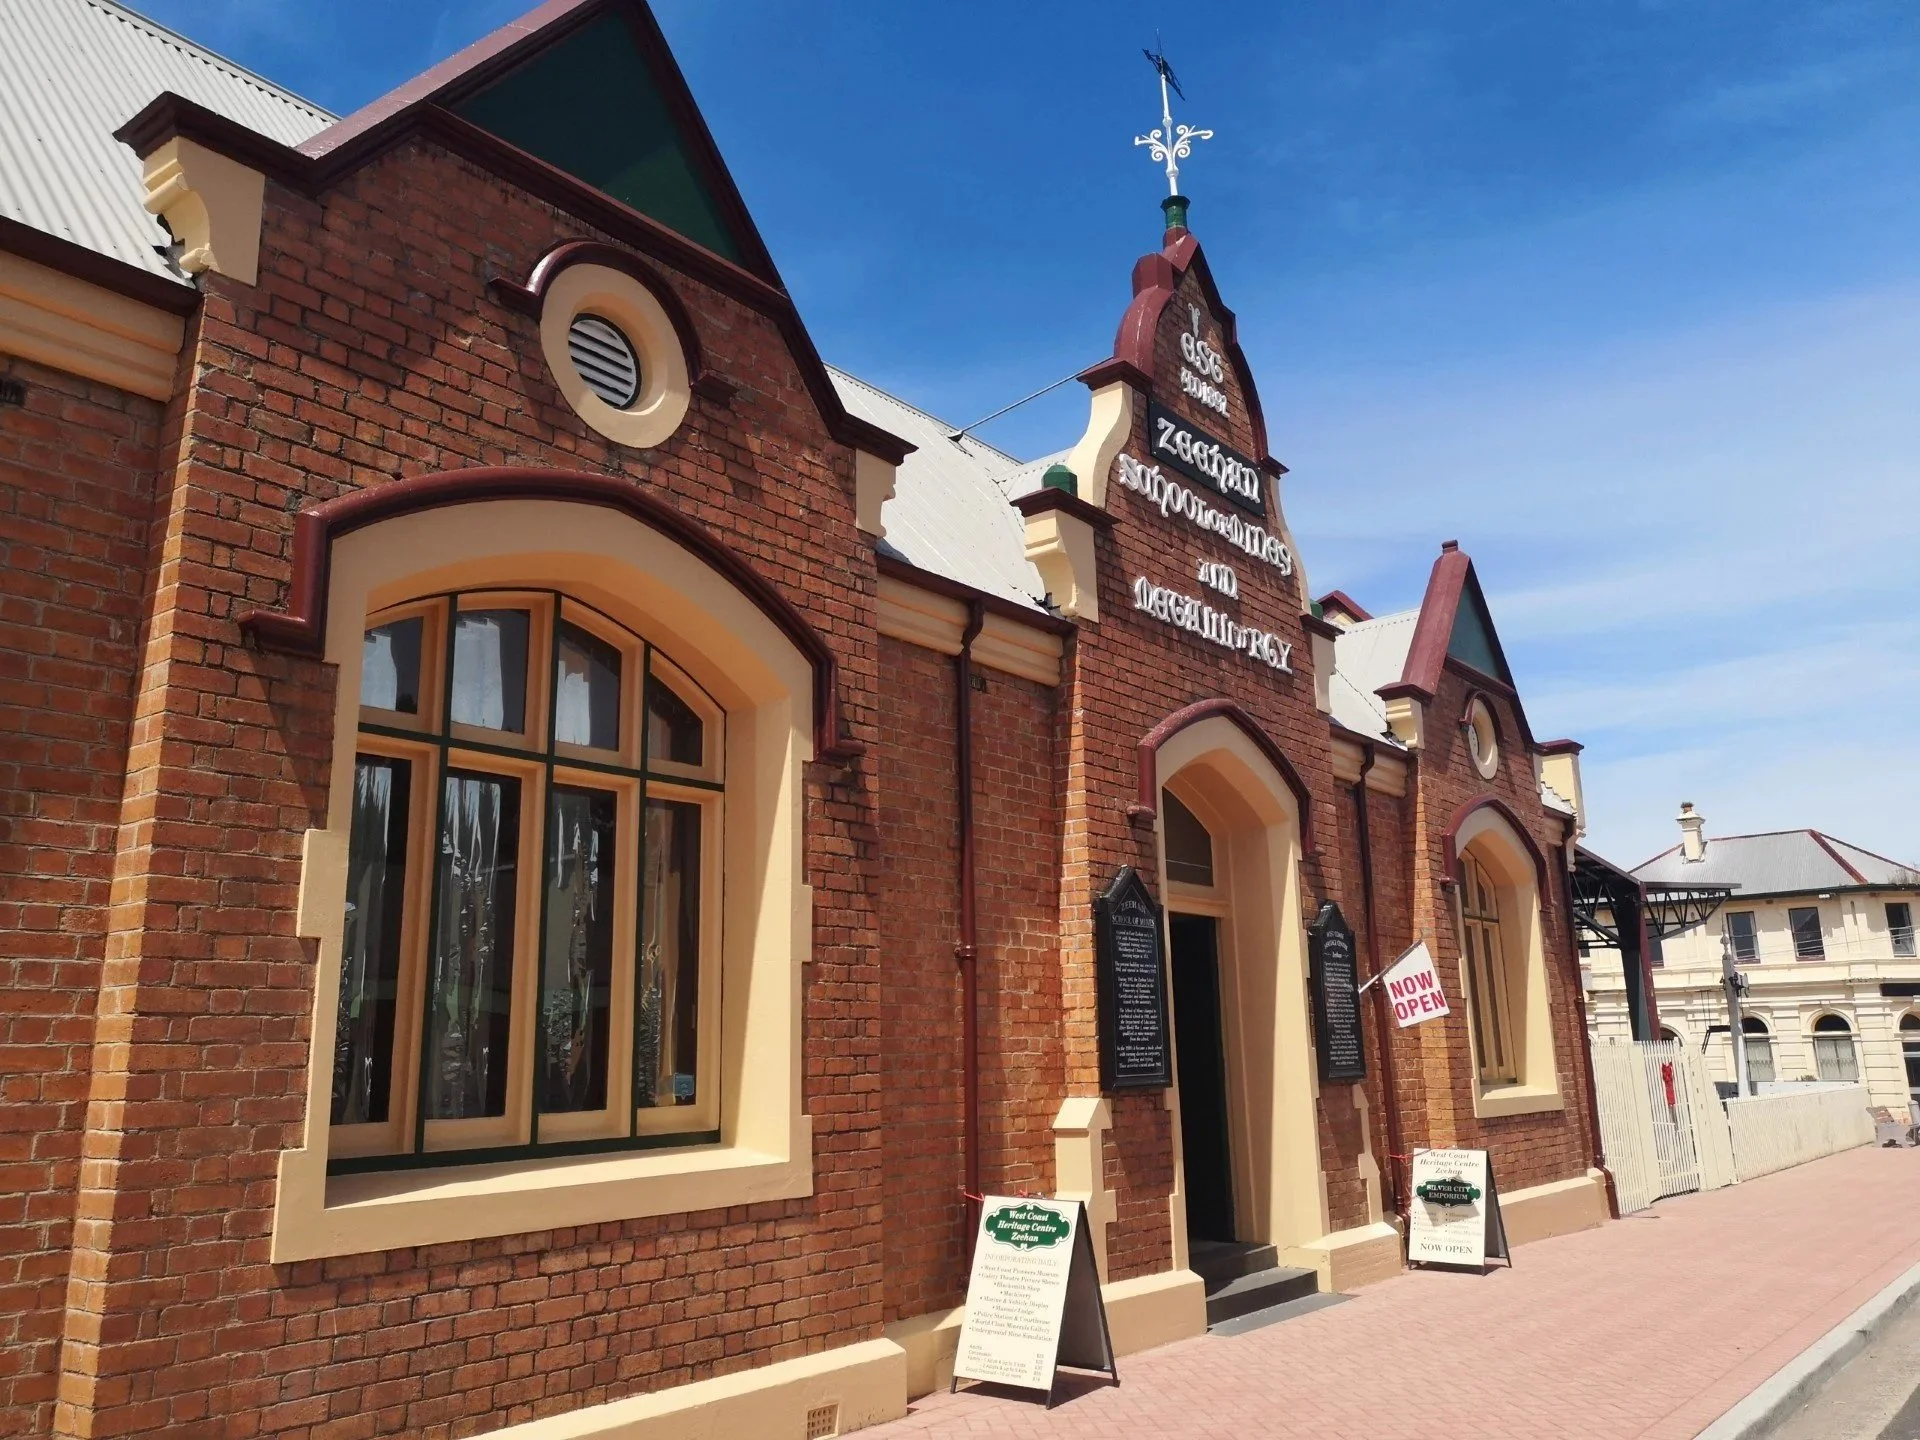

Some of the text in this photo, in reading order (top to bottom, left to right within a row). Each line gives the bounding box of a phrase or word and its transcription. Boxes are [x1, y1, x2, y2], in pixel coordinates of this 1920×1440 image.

[1157, 417, 1260, 503] ZEEHAN
[1119, 453, 1210, 530] SCHOOL
[1228, 514, 1293, 577] MINES
[1197, 558, 1239, 600] AND
[1134, 576, 1293, 674] METALLURGY
[1390, 970, 1434, 999] NOW
[1395, 990, 1446, 1020] OPEN
[1420, 1159, 1452, 1167] Heritage
[1429, 1192, 1468, 1200] EMPORIUM
[1009, 1210, 1048, 1221] West Coast
[997, 1220, 1056, 1232] Heritage Centre
[1011, 1232, 1038, 1242] Zeehan
[1420, 1243, 1473, 1254] NOW OPEN
